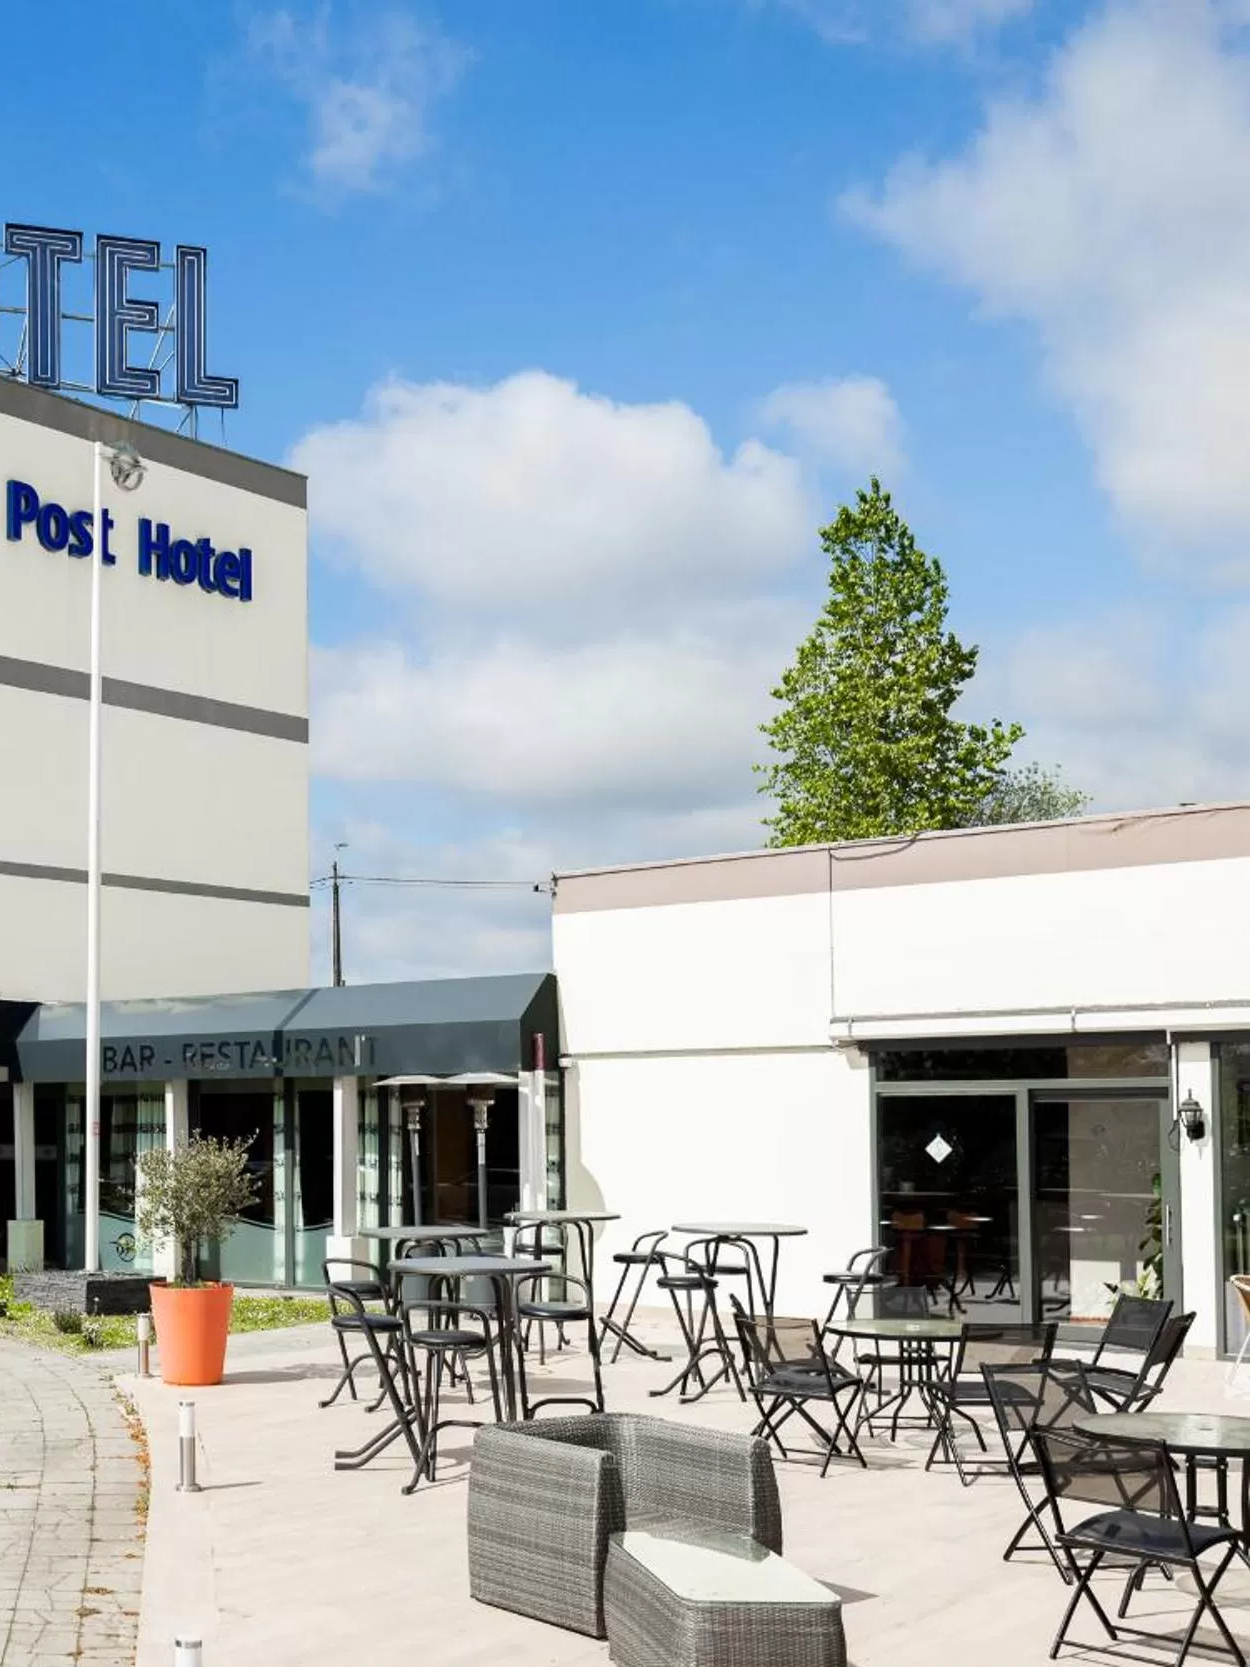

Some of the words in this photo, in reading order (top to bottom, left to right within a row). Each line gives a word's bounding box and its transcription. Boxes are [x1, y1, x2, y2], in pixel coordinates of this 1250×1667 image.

[6, 480, 116, 565] Post
[138, 518, 252, 601] Hotel
[103, 1045, 155, 1073] BAR
